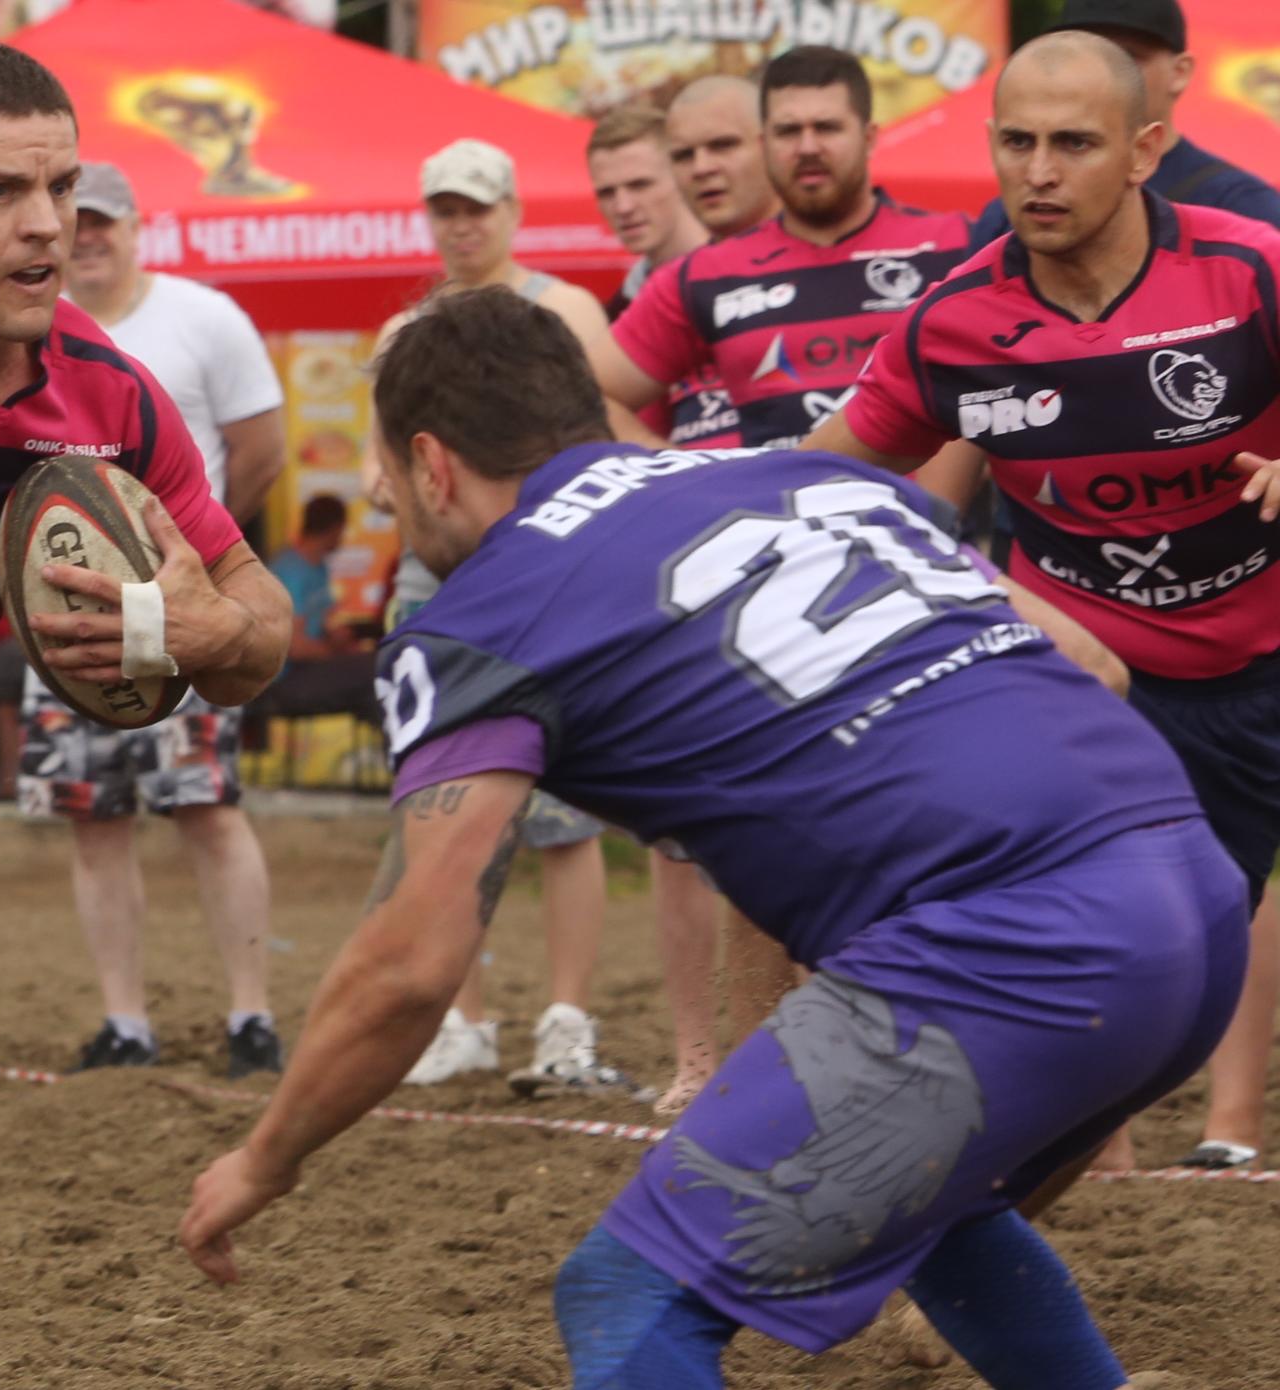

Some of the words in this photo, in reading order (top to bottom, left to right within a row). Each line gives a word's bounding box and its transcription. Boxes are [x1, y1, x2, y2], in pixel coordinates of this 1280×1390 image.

[438, 5, 570, 87] МИР
[190, 210, 437, 264] ЧЕМПИОНА
[957, 388, 1063, 439] PRO
[659, 478, 1007, 705] 20
